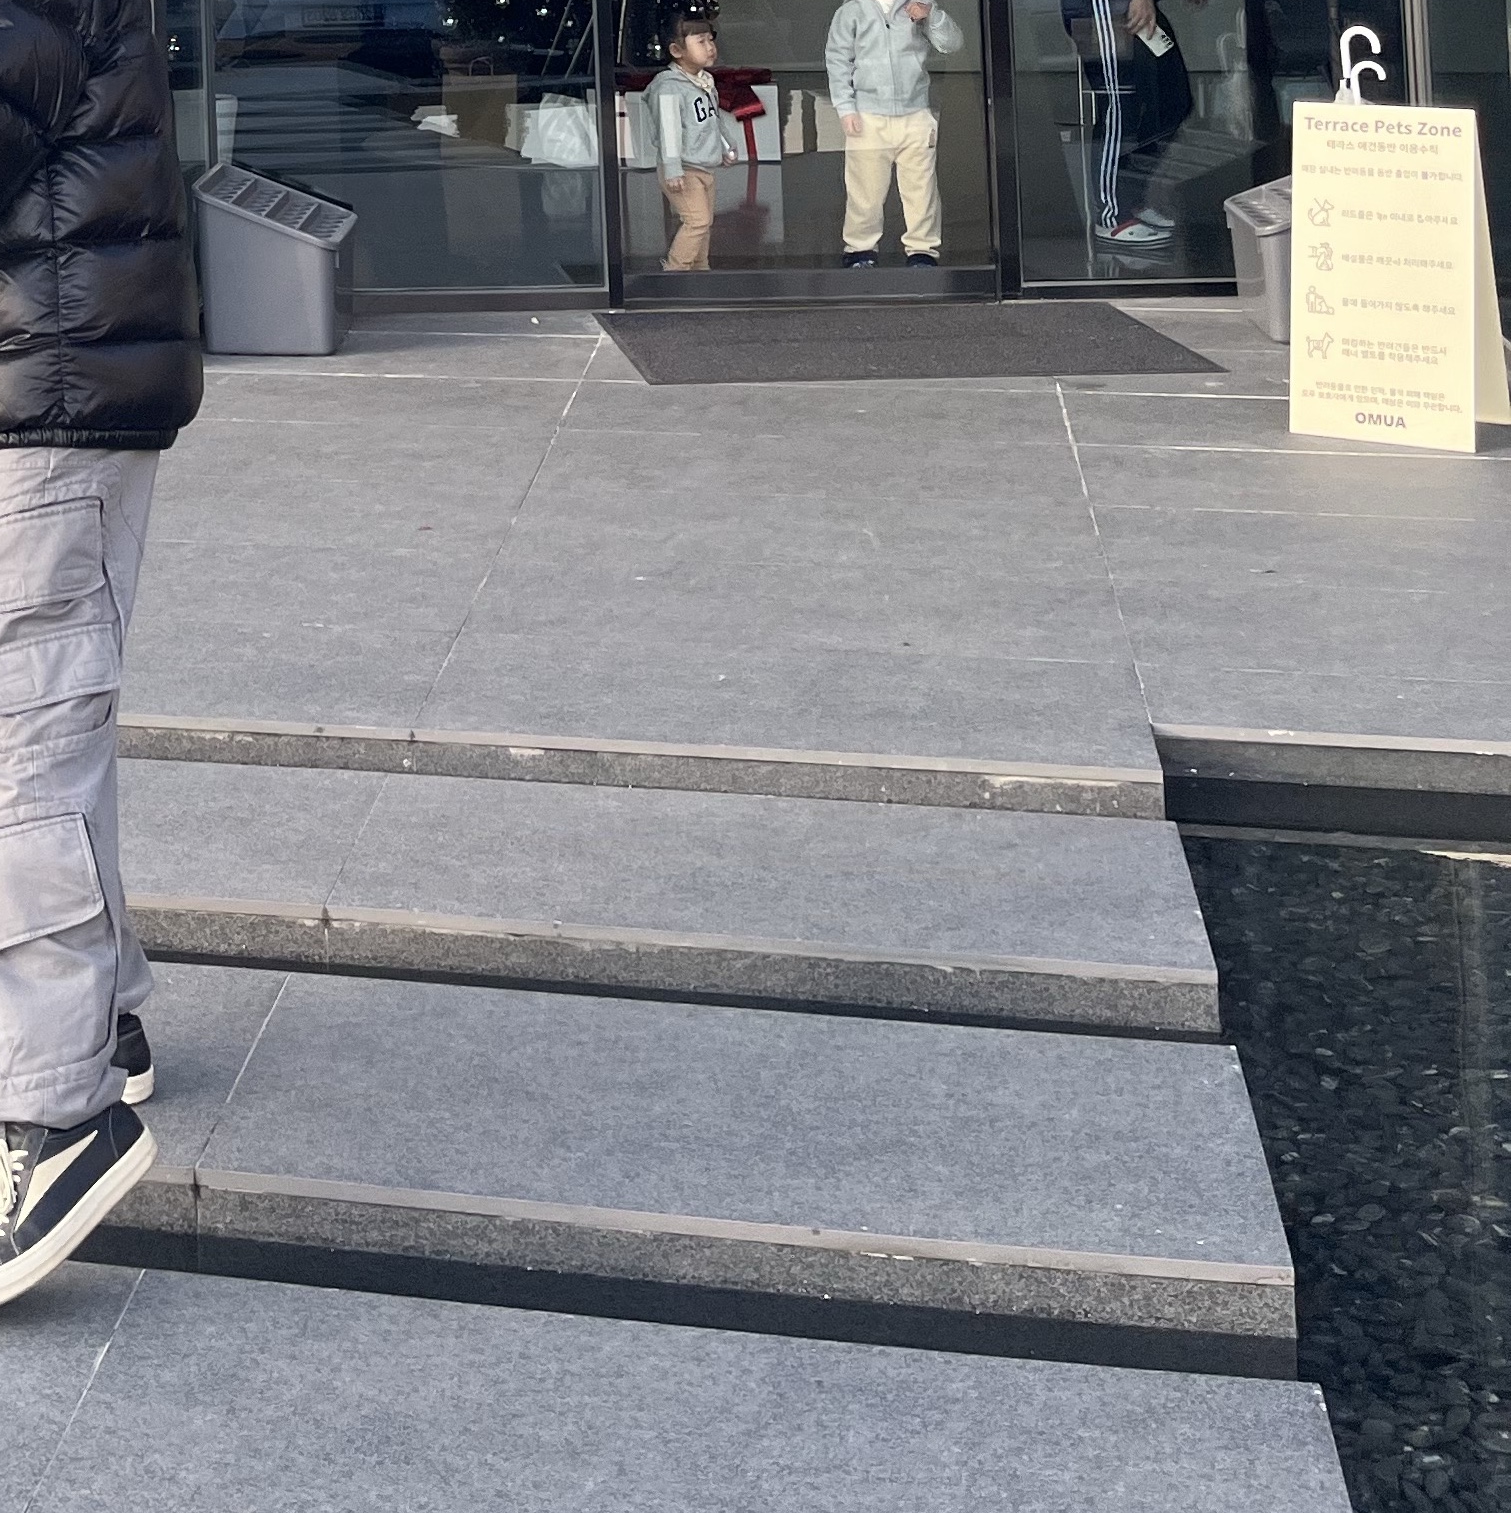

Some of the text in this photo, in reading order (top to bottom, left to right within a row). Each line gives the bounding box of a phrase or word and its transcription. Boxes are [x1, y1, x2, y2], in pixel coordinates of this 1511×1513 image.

[1303, 116, 1462, 138] Terrace Pets Zone
[1326, 139, 1356, 151] 테라스
[1354, 412, 1408, 429] OMUA
